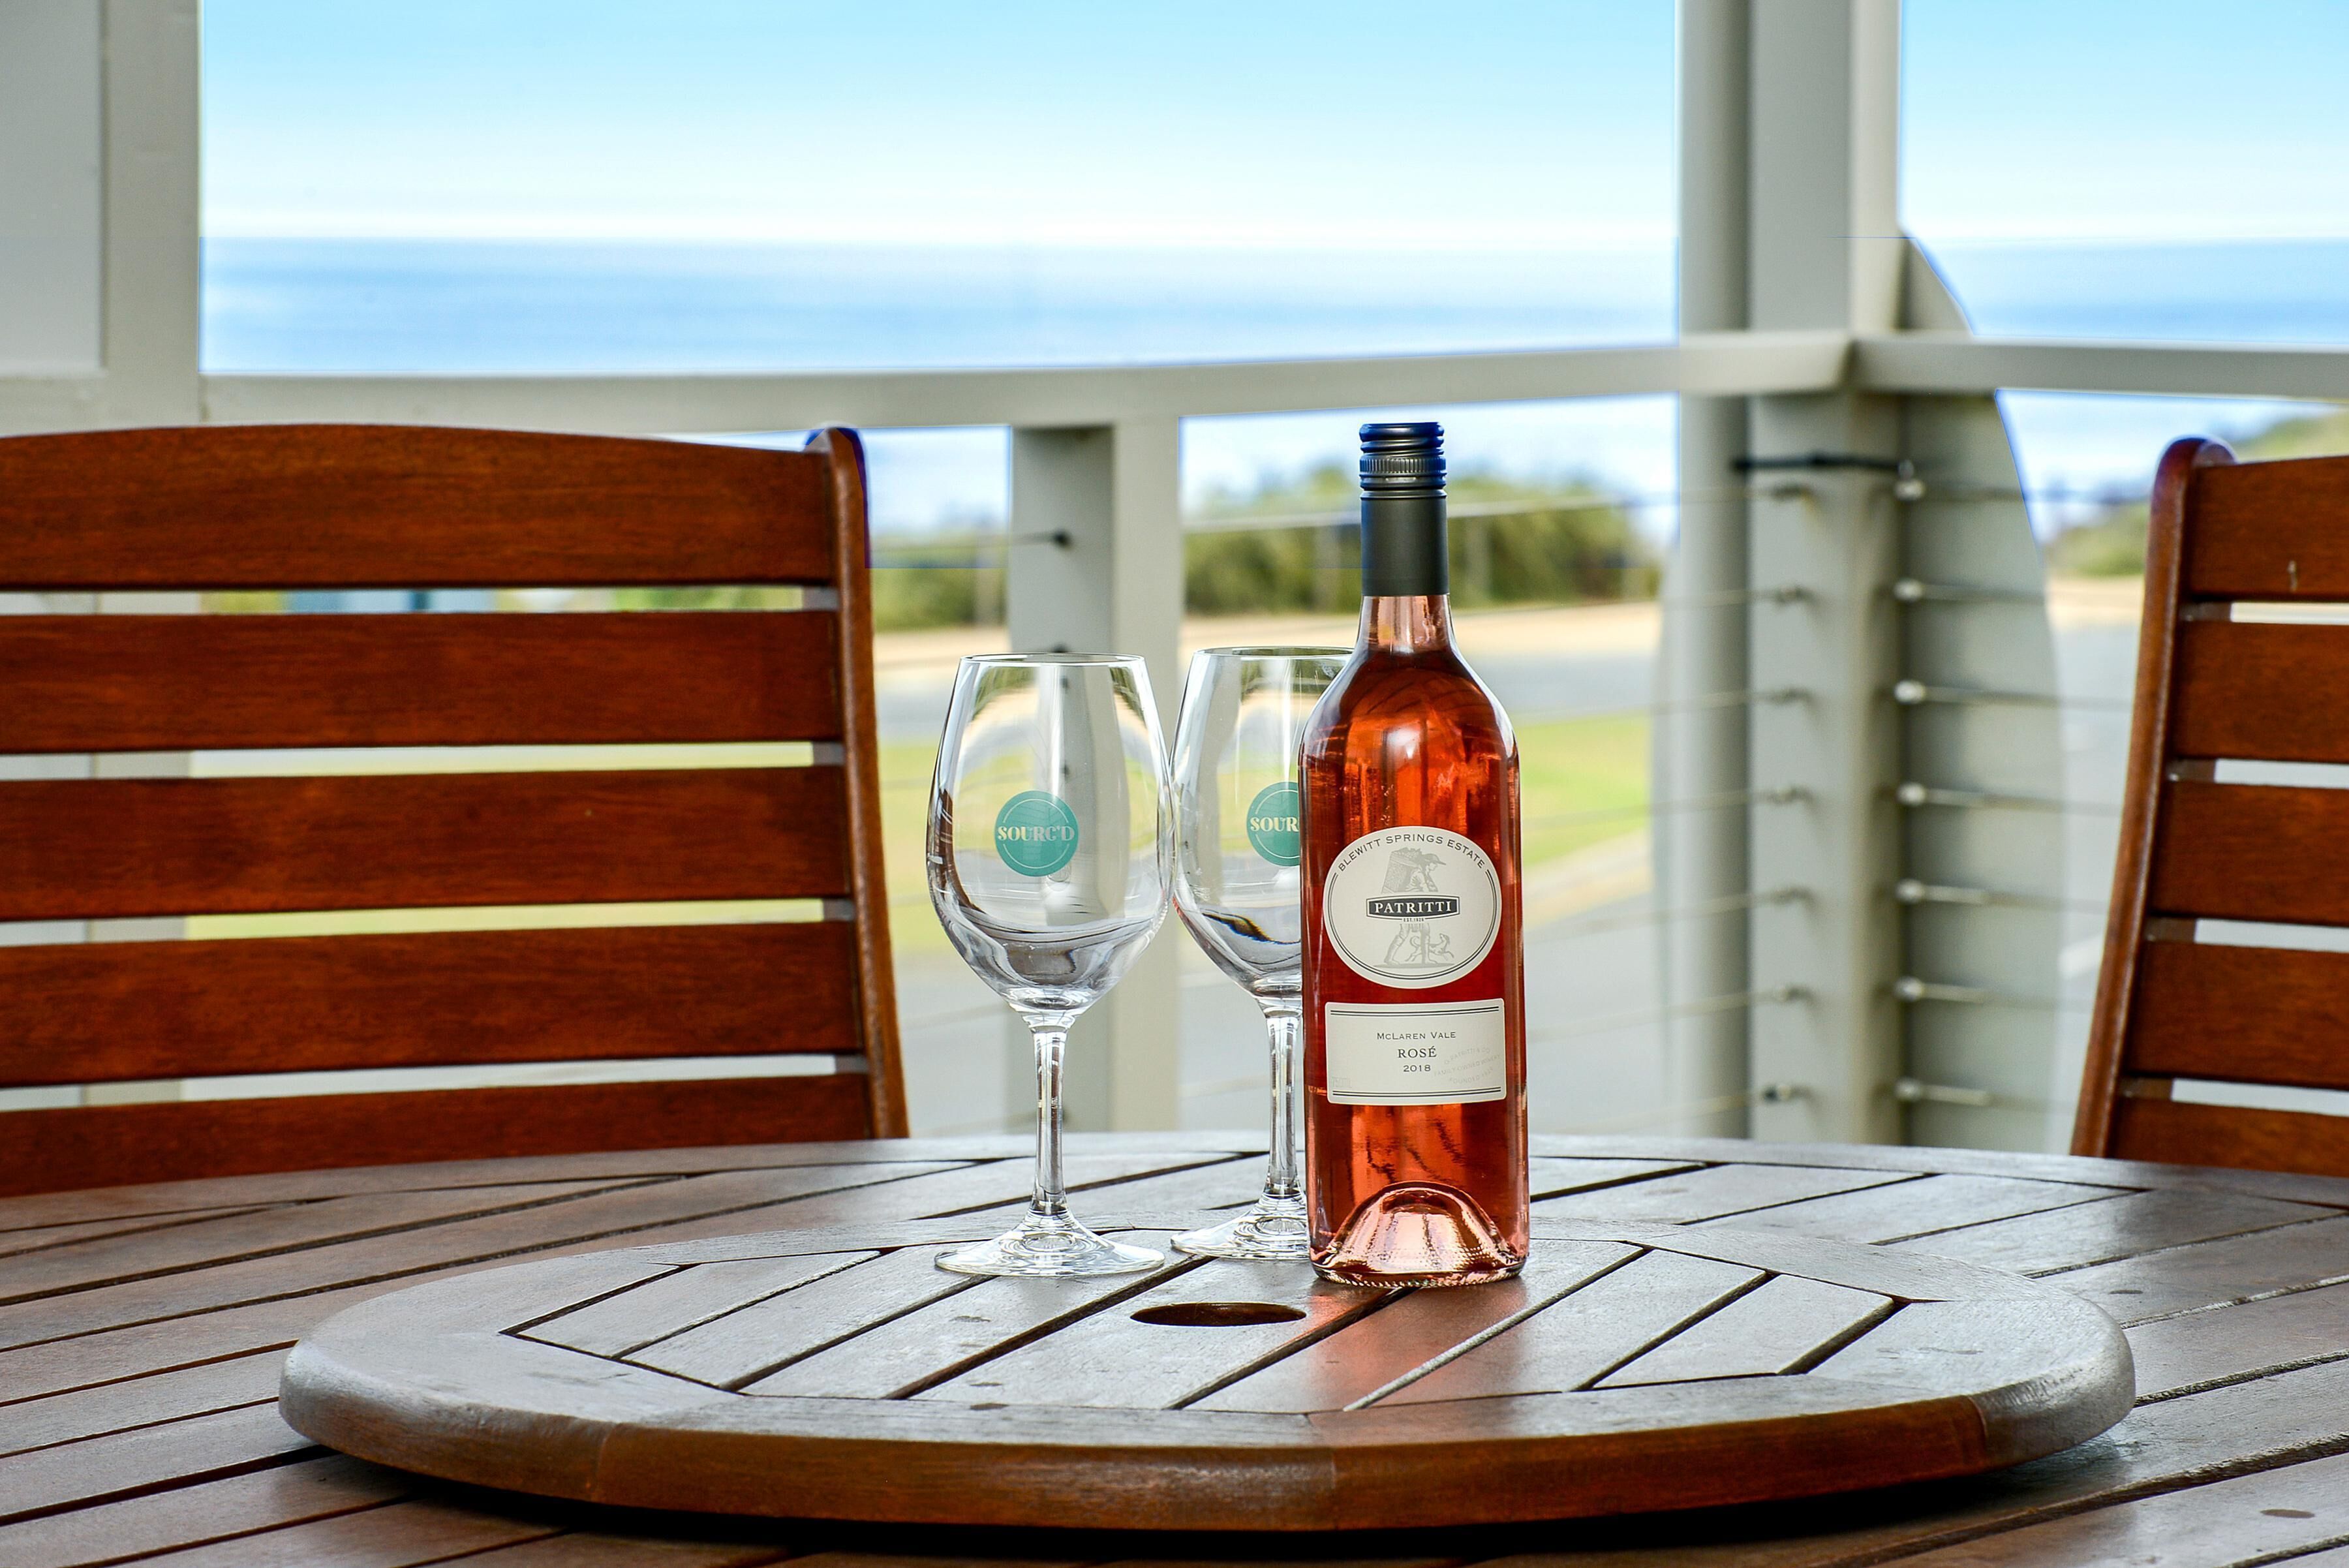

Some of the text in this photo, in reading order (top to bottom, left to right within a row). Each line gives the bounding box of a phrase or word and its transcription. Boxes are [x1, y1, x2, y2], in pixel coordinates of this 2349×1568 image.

[997, 825, 1075, 842] SOURC'D
[1338, 833, 1486, 872] BLEWITT SPRINGS ESTATE
[1374, 900, 1452, 914] PATRITTI
[1397, 1045, 1437, 1058] ROSÉ
